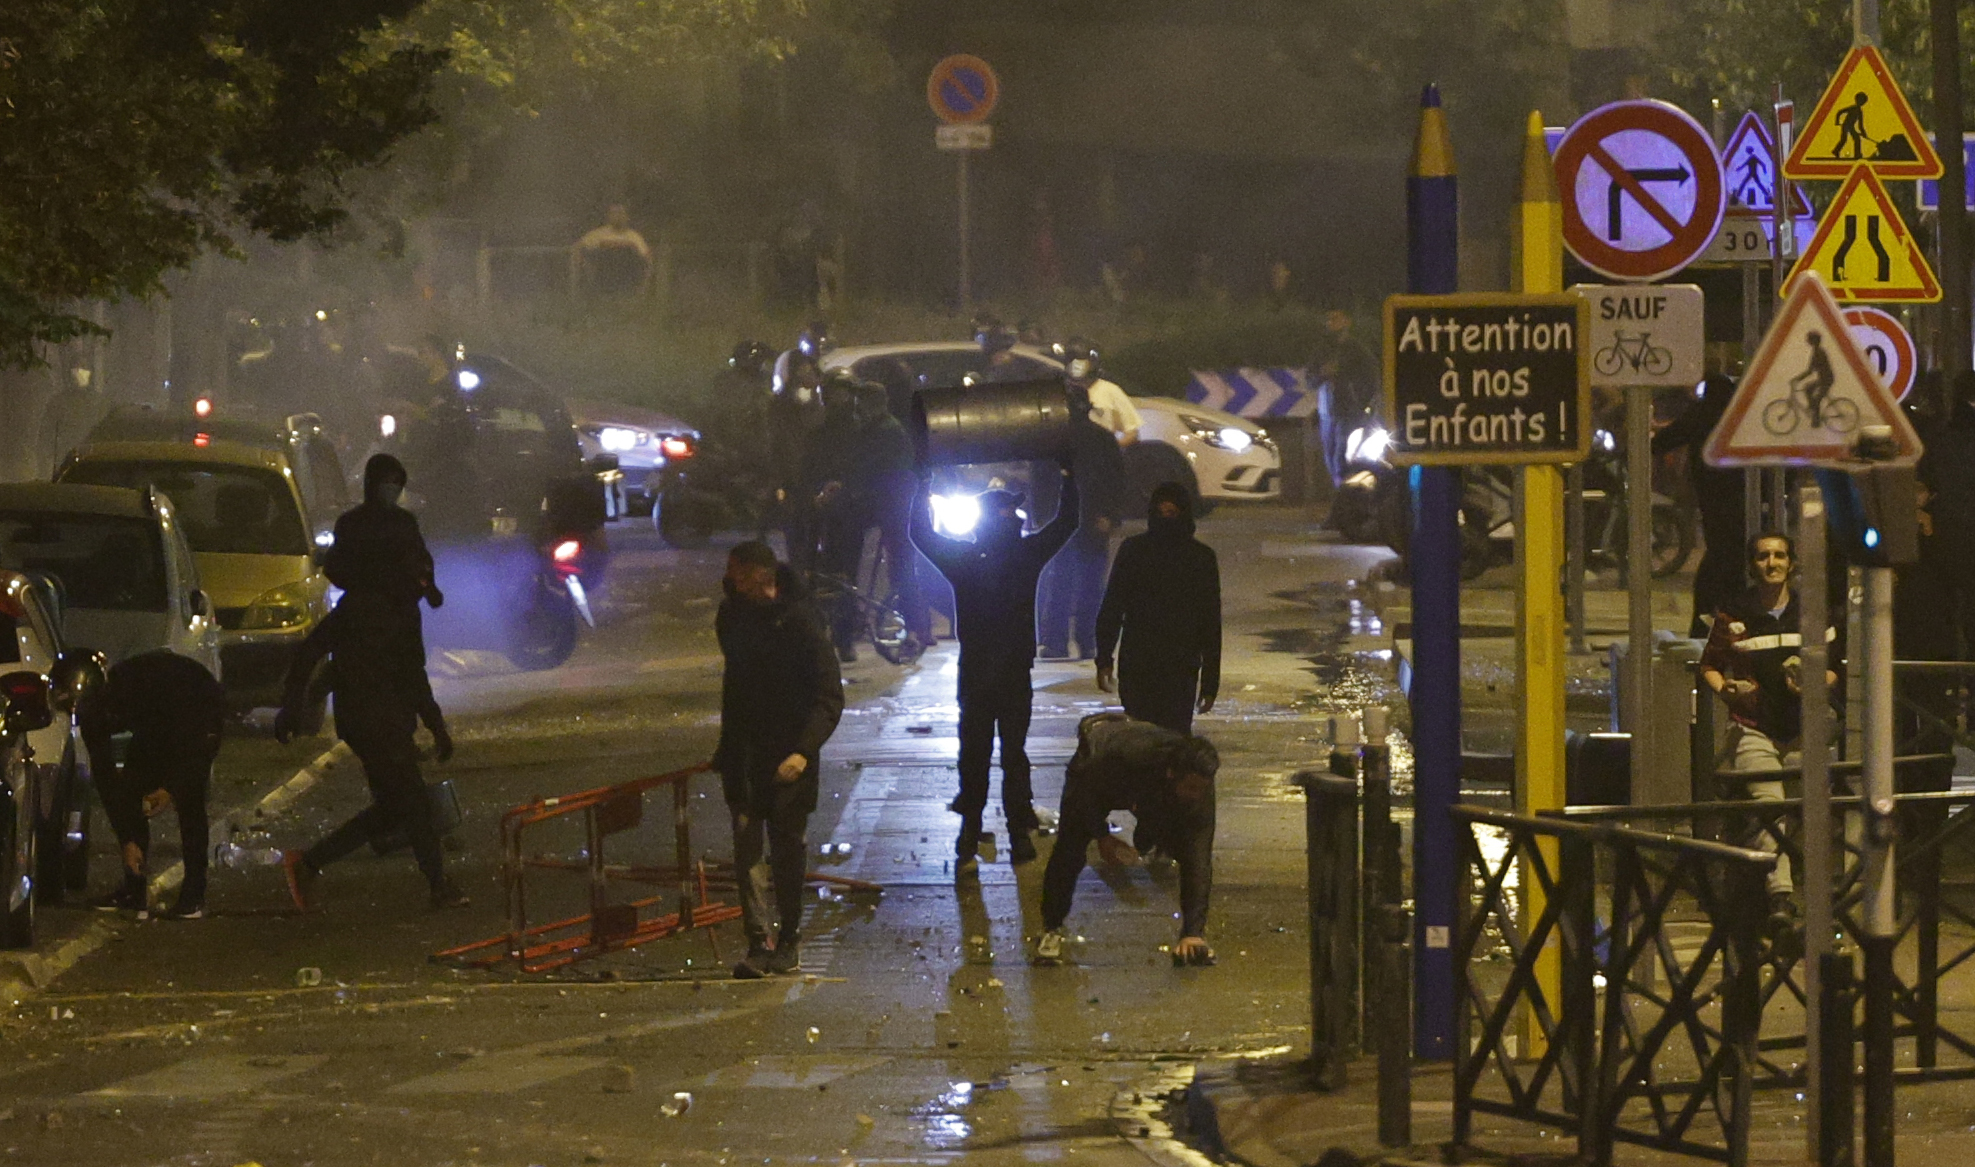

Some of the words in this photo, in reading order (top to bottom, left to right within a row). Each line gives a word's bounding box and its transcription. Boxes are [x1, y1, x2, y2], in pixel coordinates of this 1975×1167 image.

[1600, 296, 1667, 320] SAUF
[1398, 313, 1573, 352] Attention
[1440, 357, 1460, 398] à
[1472, 366, 1531, 397] nos
[1865, 344, 1887, 377] 0
[1406, 402, 1546, 446] Enfants
[1559, 400, 1566, 441] !
